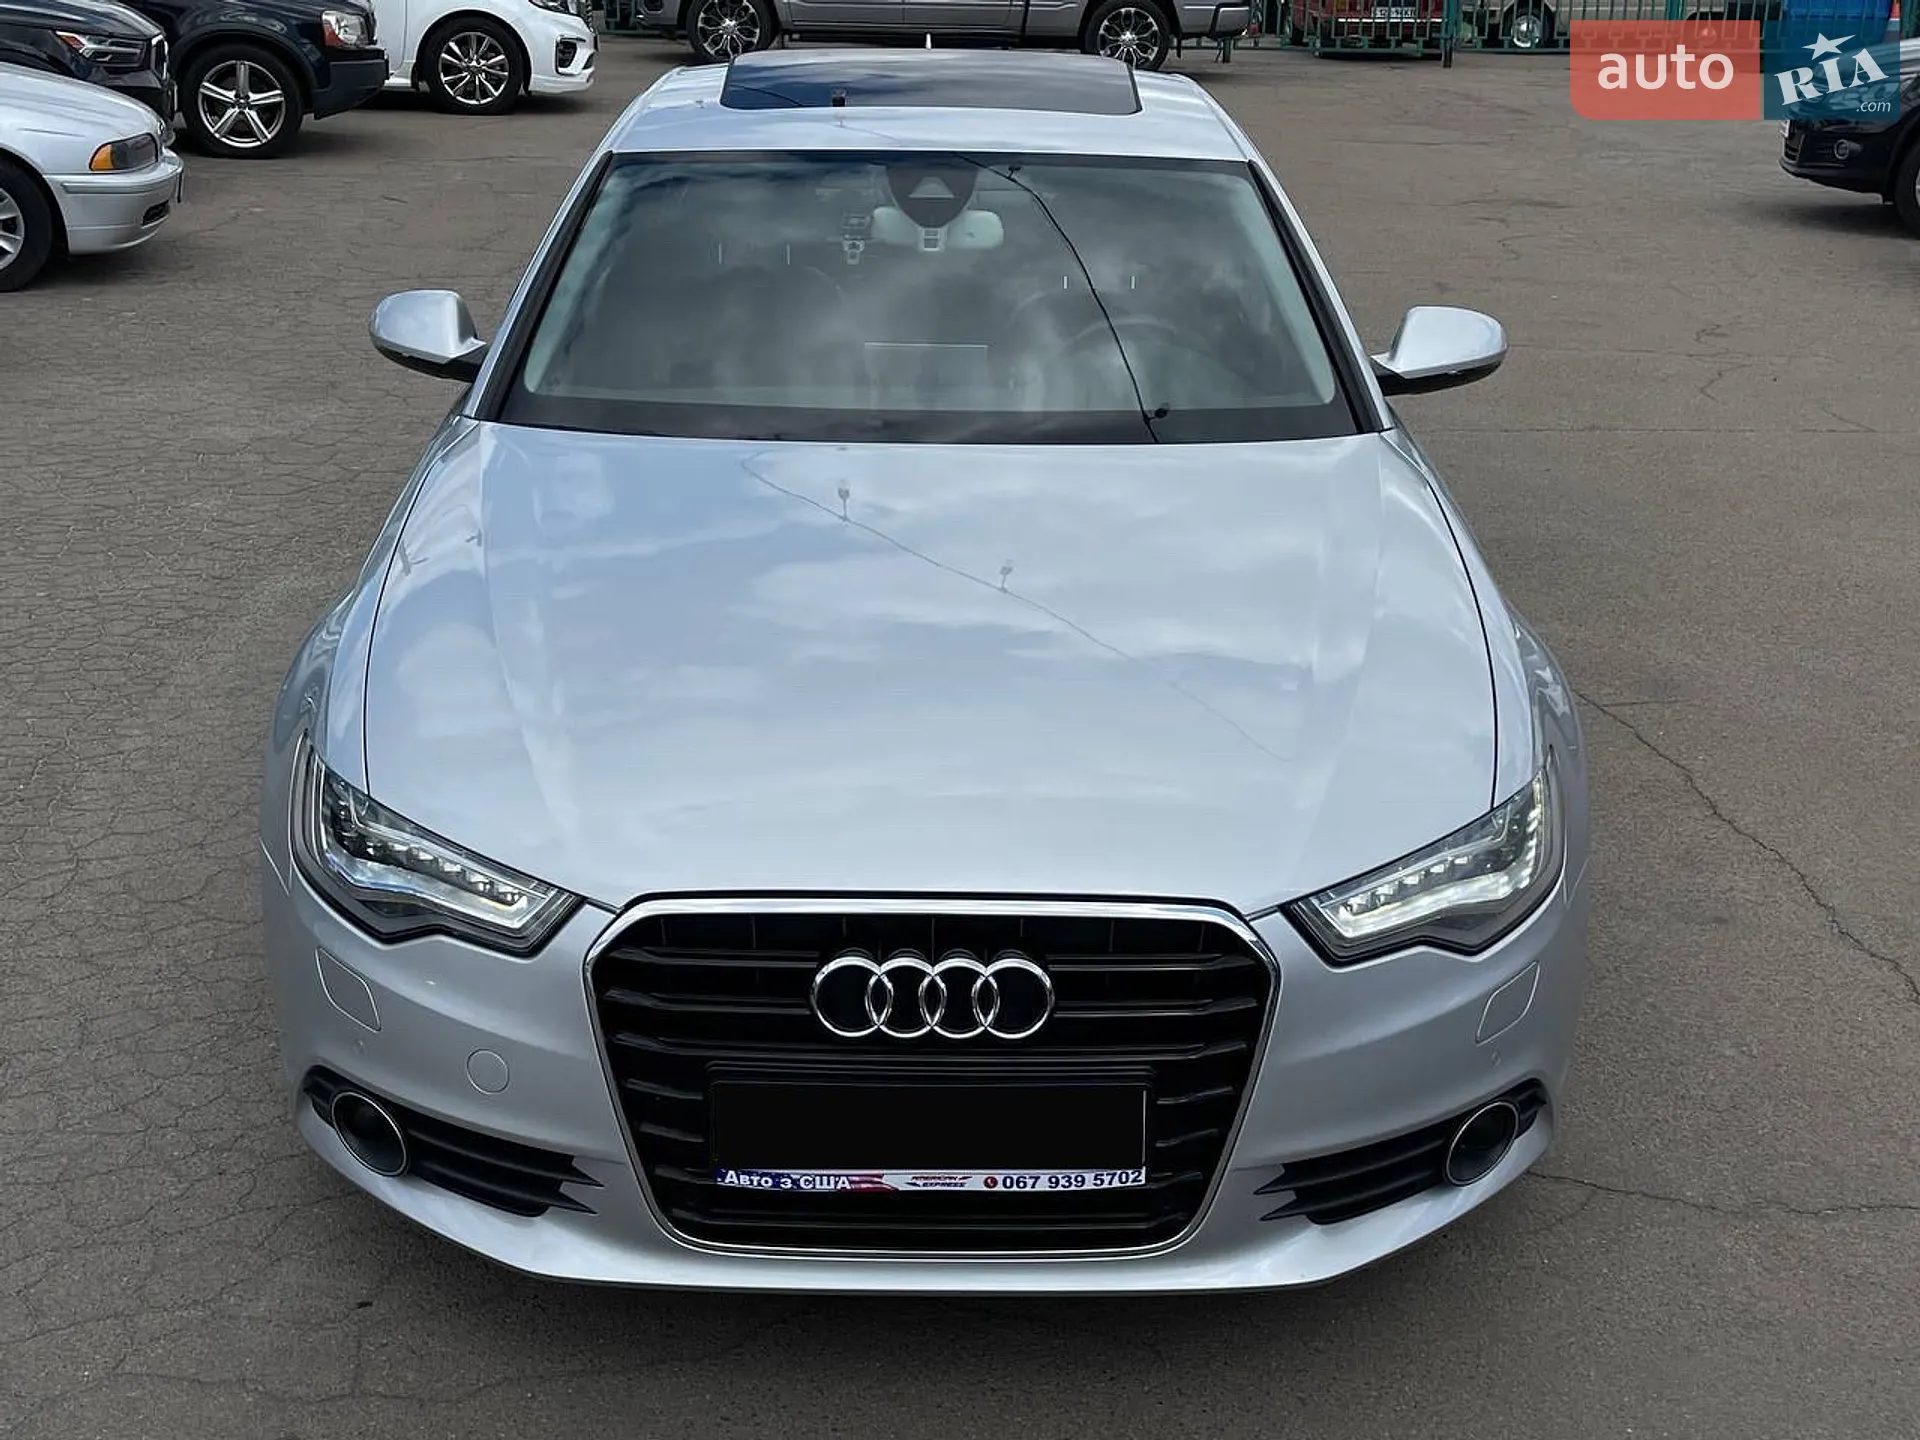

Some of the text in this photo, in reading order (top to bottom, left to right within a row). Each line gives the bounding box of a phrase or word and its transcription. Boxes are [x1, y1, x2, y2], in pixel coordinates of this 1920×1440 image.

[724, 1170, 773, 1187] Авто
[799, 1175, 851, 1190] США
[1002, 1170, 1143, 1189] 067 939 5702
